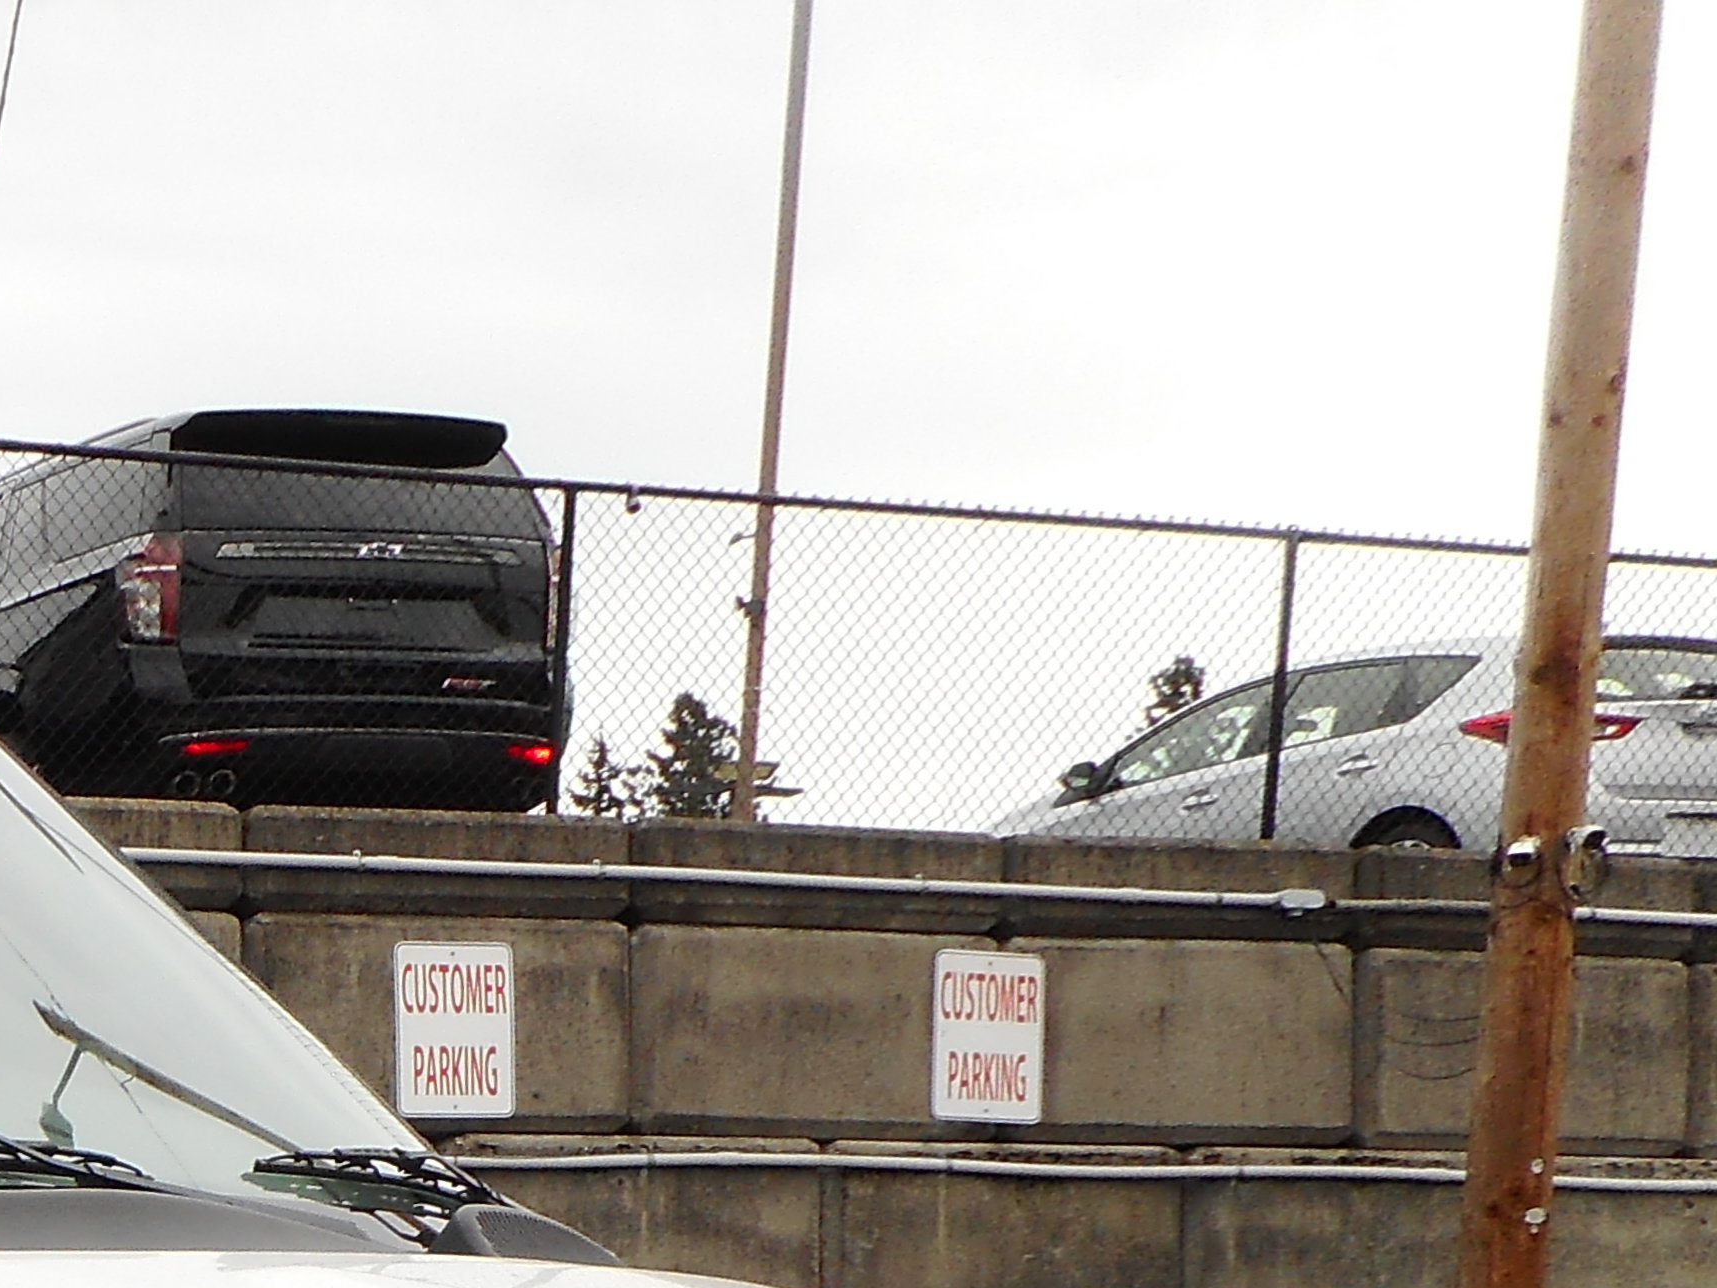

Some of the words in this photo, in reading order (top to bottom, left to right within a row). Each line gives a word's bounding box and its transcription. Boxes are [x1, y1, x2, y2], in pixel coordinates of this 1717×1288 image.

[401, 963, 507, 1014] CUSTOMER
[940, 971, 1038, 1024] CUSTOMER
[413, 1045, 498, 1097] PARKING
[947, 1050, 1027, 1103] PARKING
